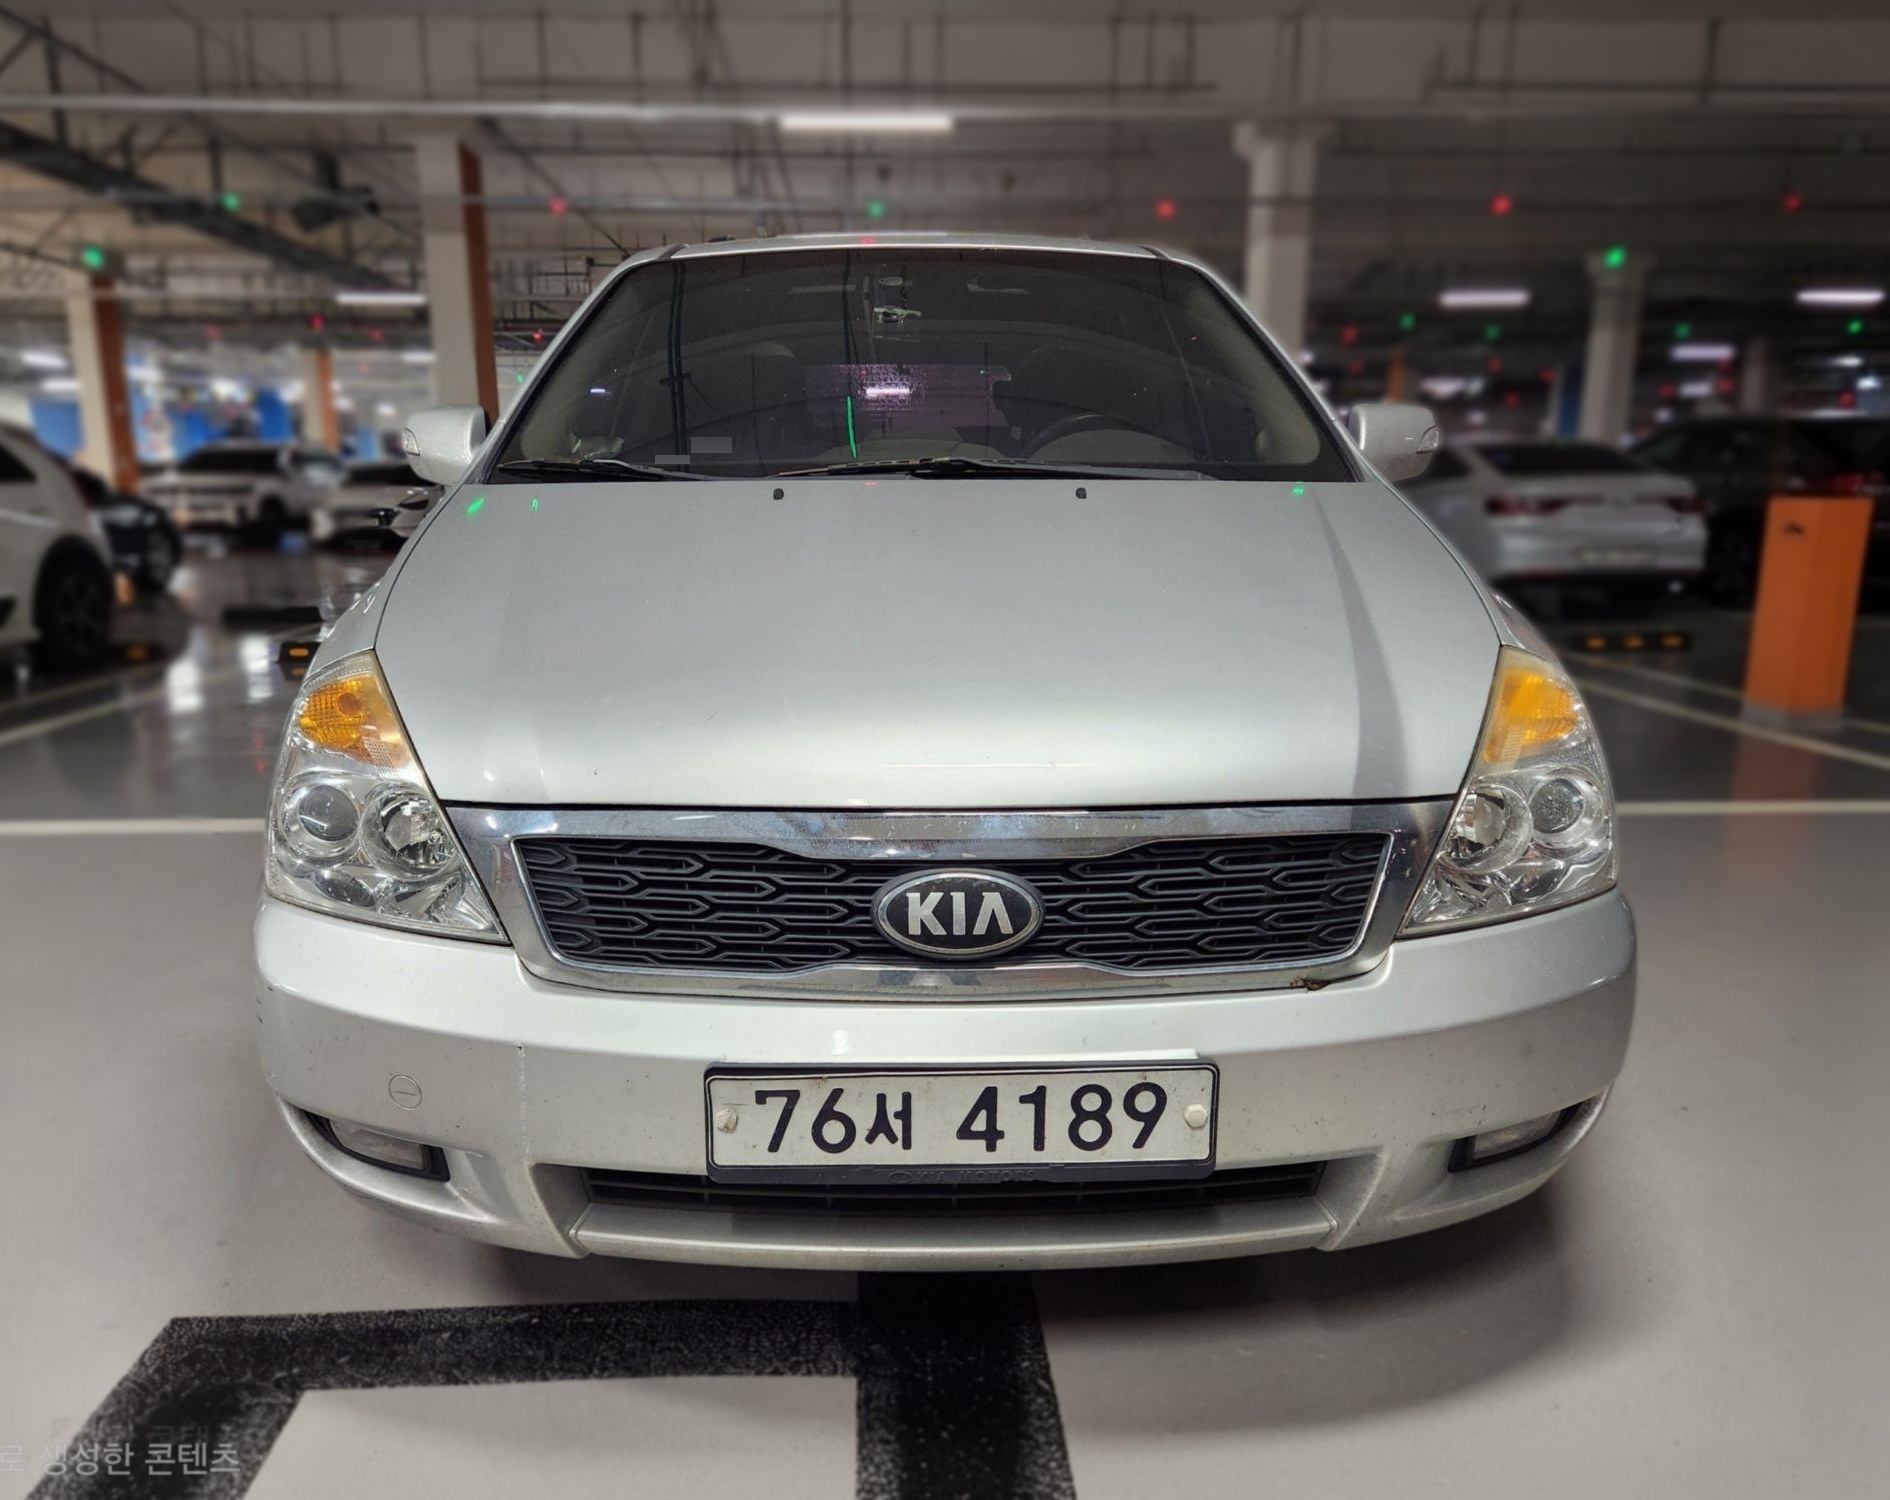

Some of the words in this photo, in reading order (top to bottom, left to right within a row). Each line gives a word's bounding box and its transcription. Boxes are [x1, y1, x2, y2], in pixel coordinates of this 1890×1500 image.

[906, 891, 1014, 936] KIA
[755, 1088, 912, 1154] 76서
[956, 1081, 1169, 1153] 4189
